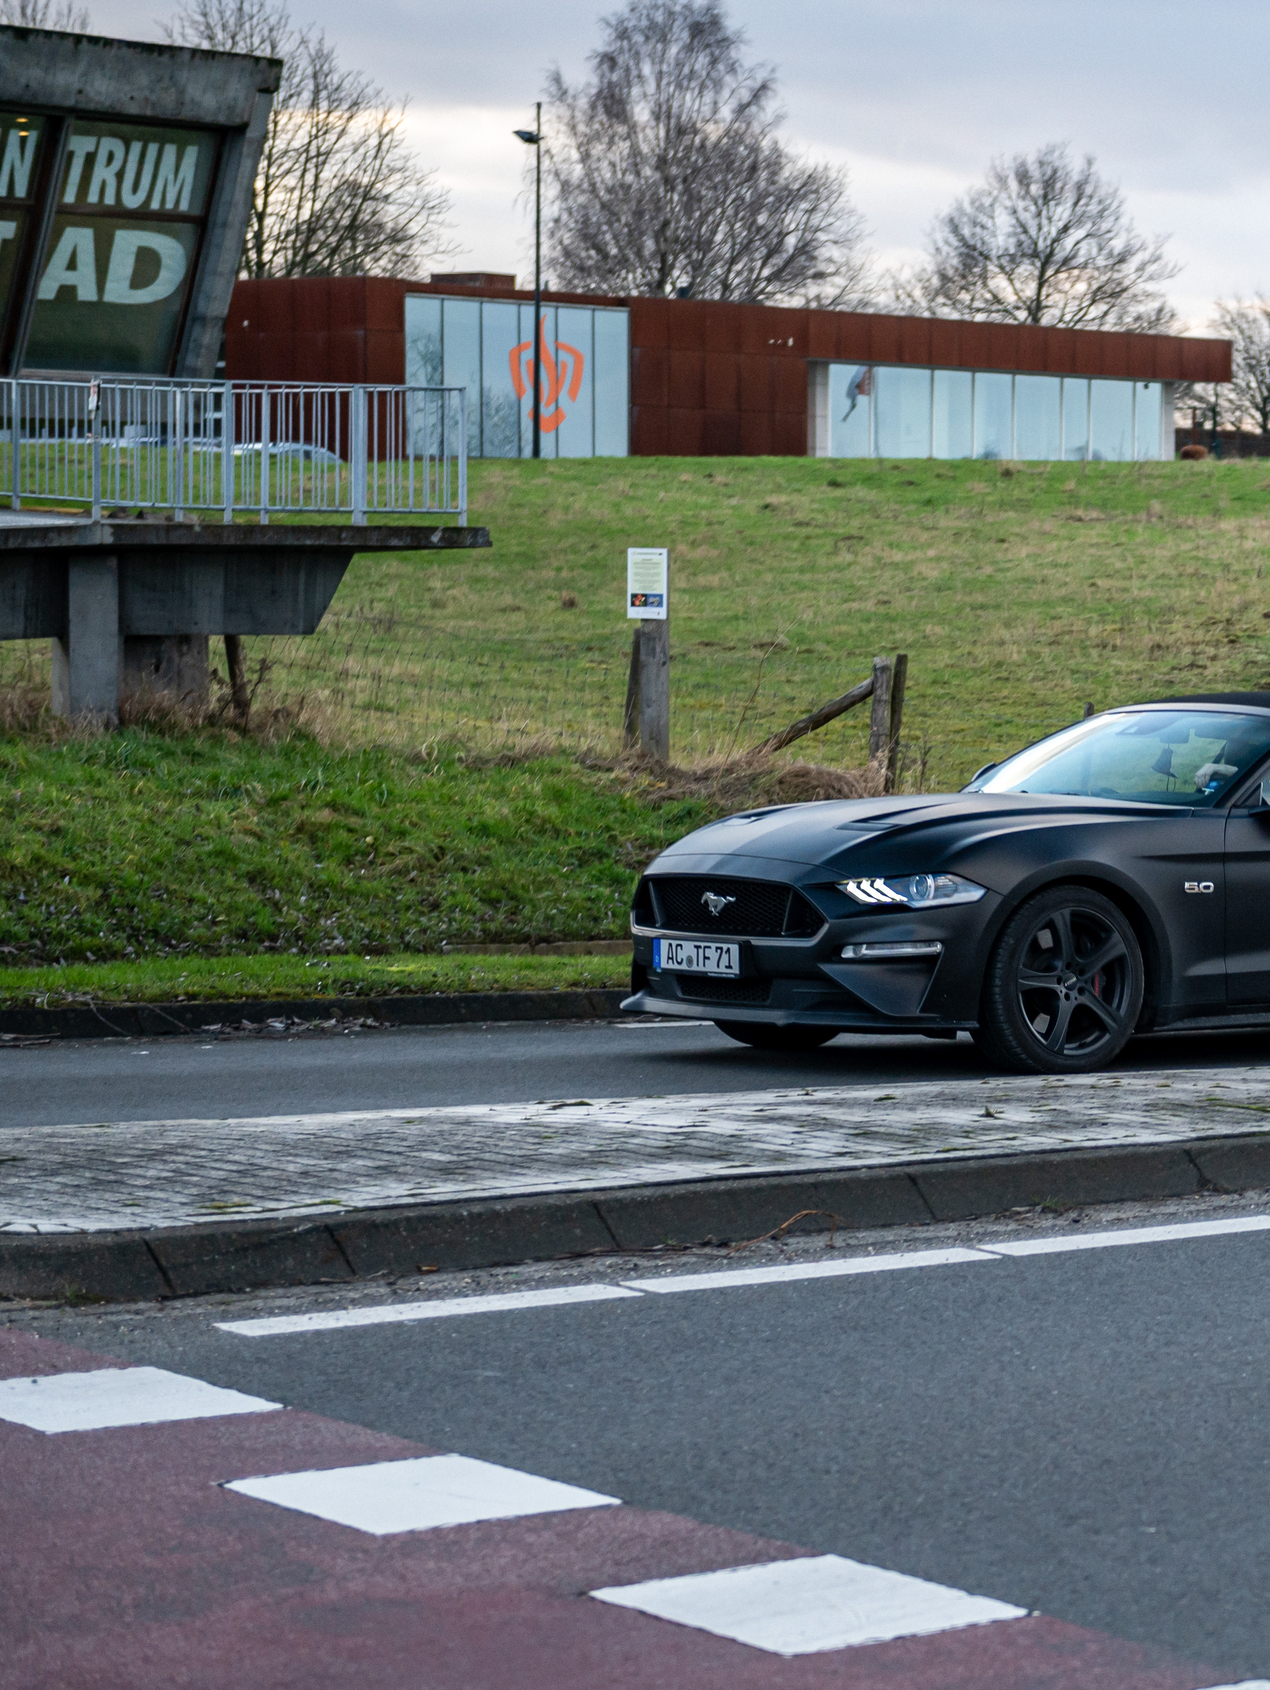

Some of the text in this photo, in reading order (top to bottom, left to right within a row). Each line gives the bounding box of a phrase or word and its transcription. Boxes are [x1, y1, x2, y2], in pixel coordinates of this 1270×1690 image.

[0, 128, 199, 211] NTRUM
[0, 221, 187, 304] AD
[666, 942, 734, 970] AC TF 71
